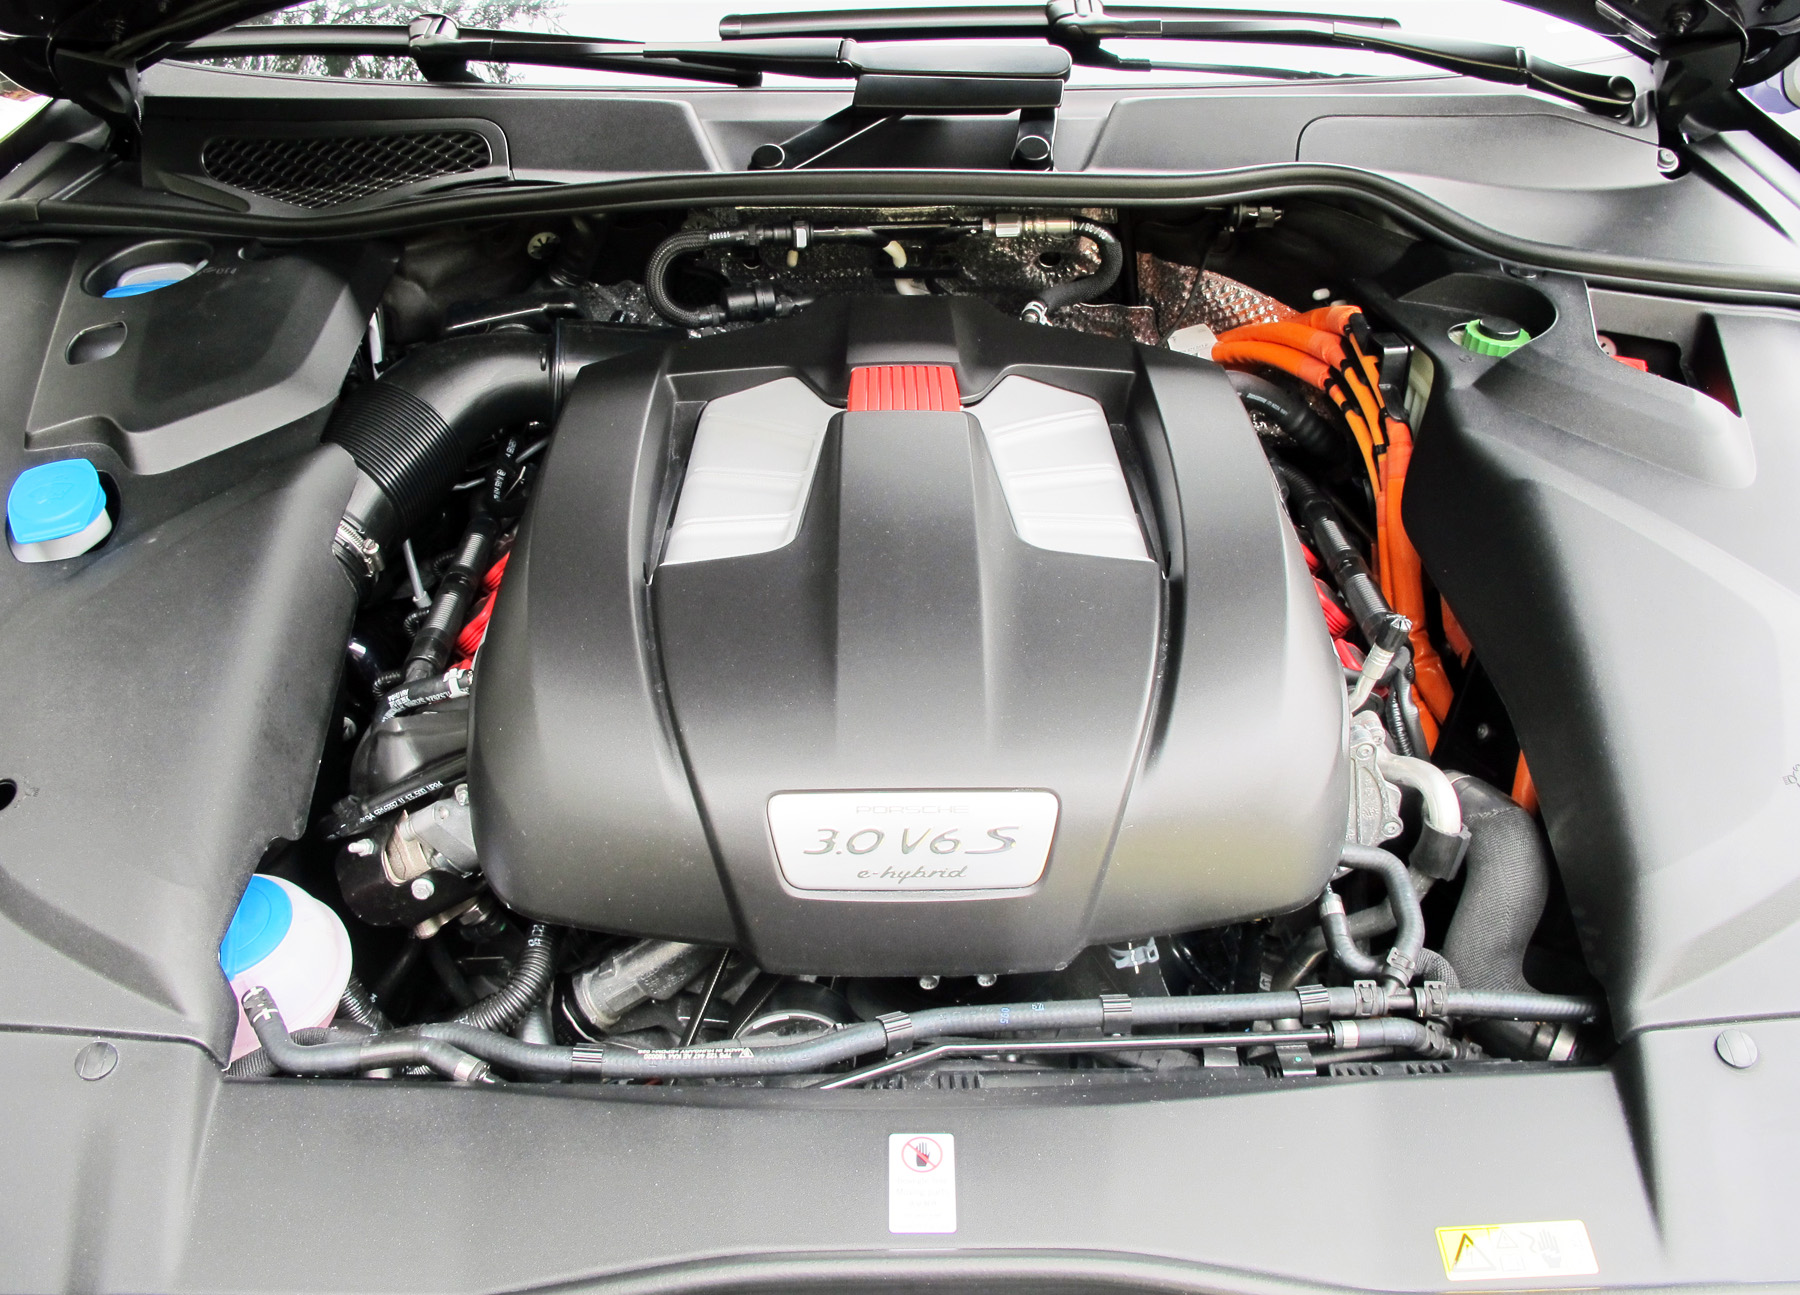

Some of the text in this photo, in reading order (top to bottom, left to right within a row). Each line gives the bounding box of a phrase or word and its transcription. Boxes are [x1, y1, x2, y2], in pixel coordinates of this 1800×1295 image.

[856, 805, 969, 814] PORSCHE
[803, 826, 1020, 855] 3.0 V6 S
[856, 865, 969, 884] e-hybrid
